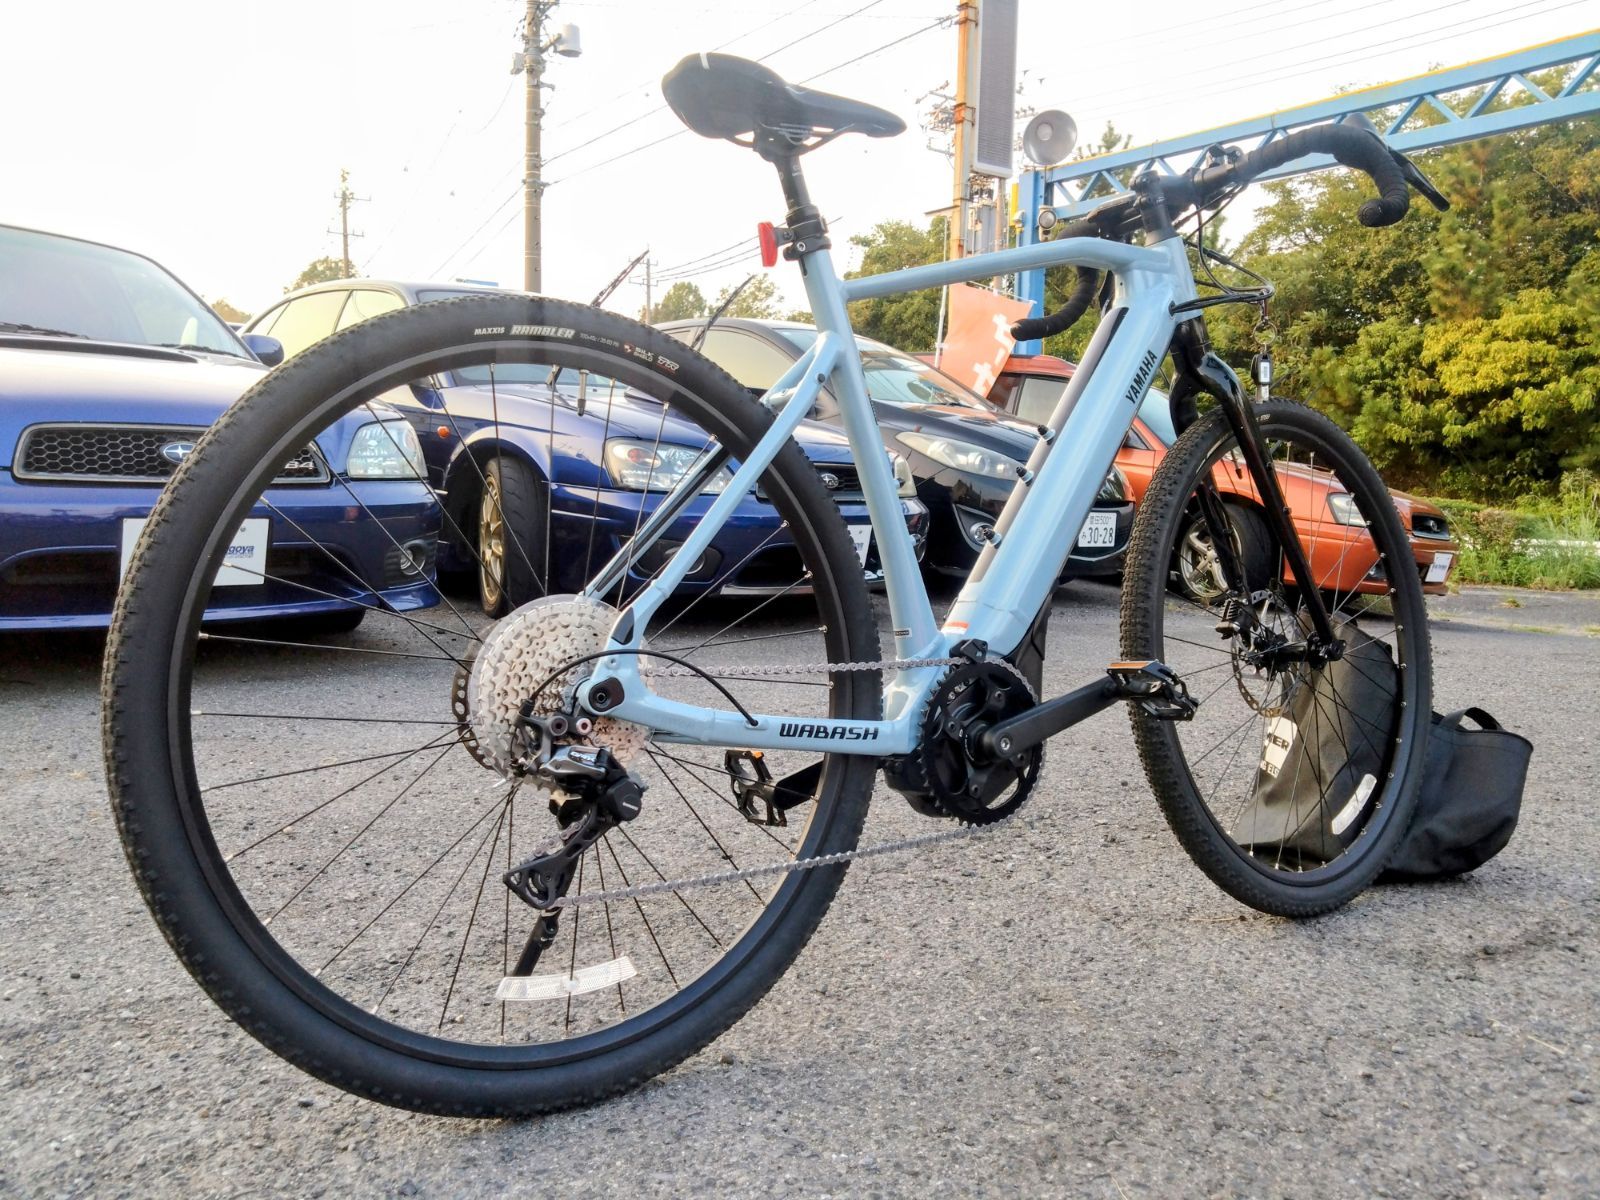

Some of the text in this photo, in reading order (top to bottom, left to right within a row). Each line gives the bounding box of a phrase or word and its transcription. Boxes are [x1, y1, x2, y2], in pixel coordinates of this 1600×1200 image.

[474, 326, 505, 336] MAXXIS
[510, 324, 576, 339] RAMBLER
[1125, 349, 1158, 404] YAMAHA
[284, 460, 315, 470] B4
[228, 544, 255, 555] goya
[779, 723, 880, 741] WABASH
